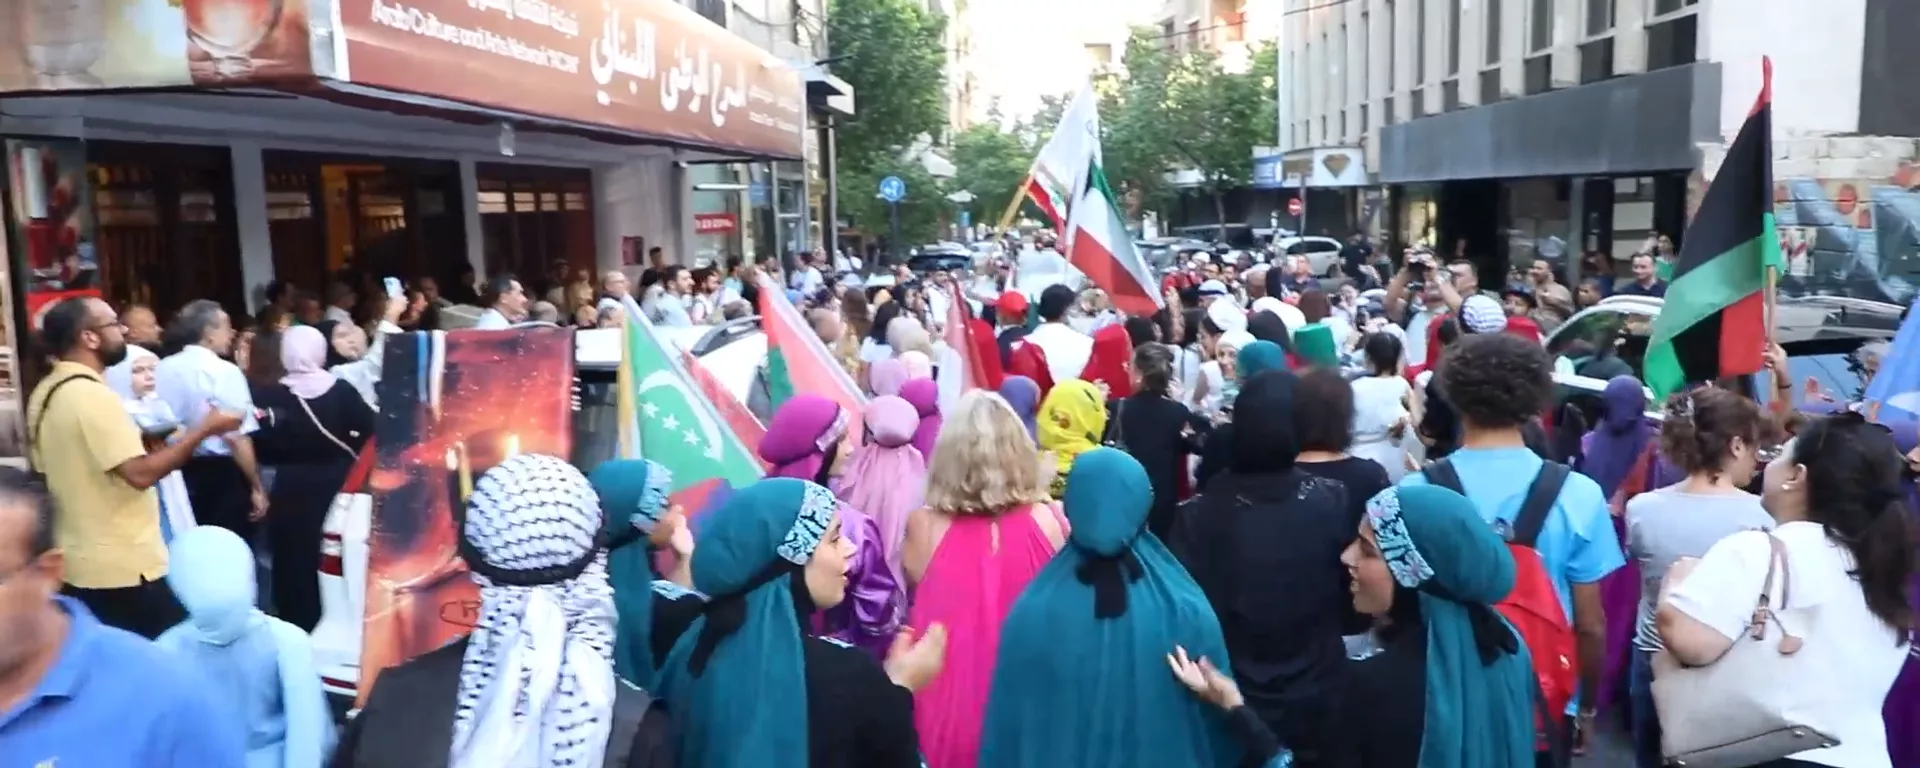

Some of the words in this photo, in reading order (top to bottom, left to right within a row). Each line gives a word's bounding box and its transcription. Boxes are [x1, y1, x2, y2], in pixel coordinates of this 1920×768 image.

[371, 0, 409, 31] Arab
[590, 2, 656, 106] اللبناني
[660, 38, 709, 112] الوطني
